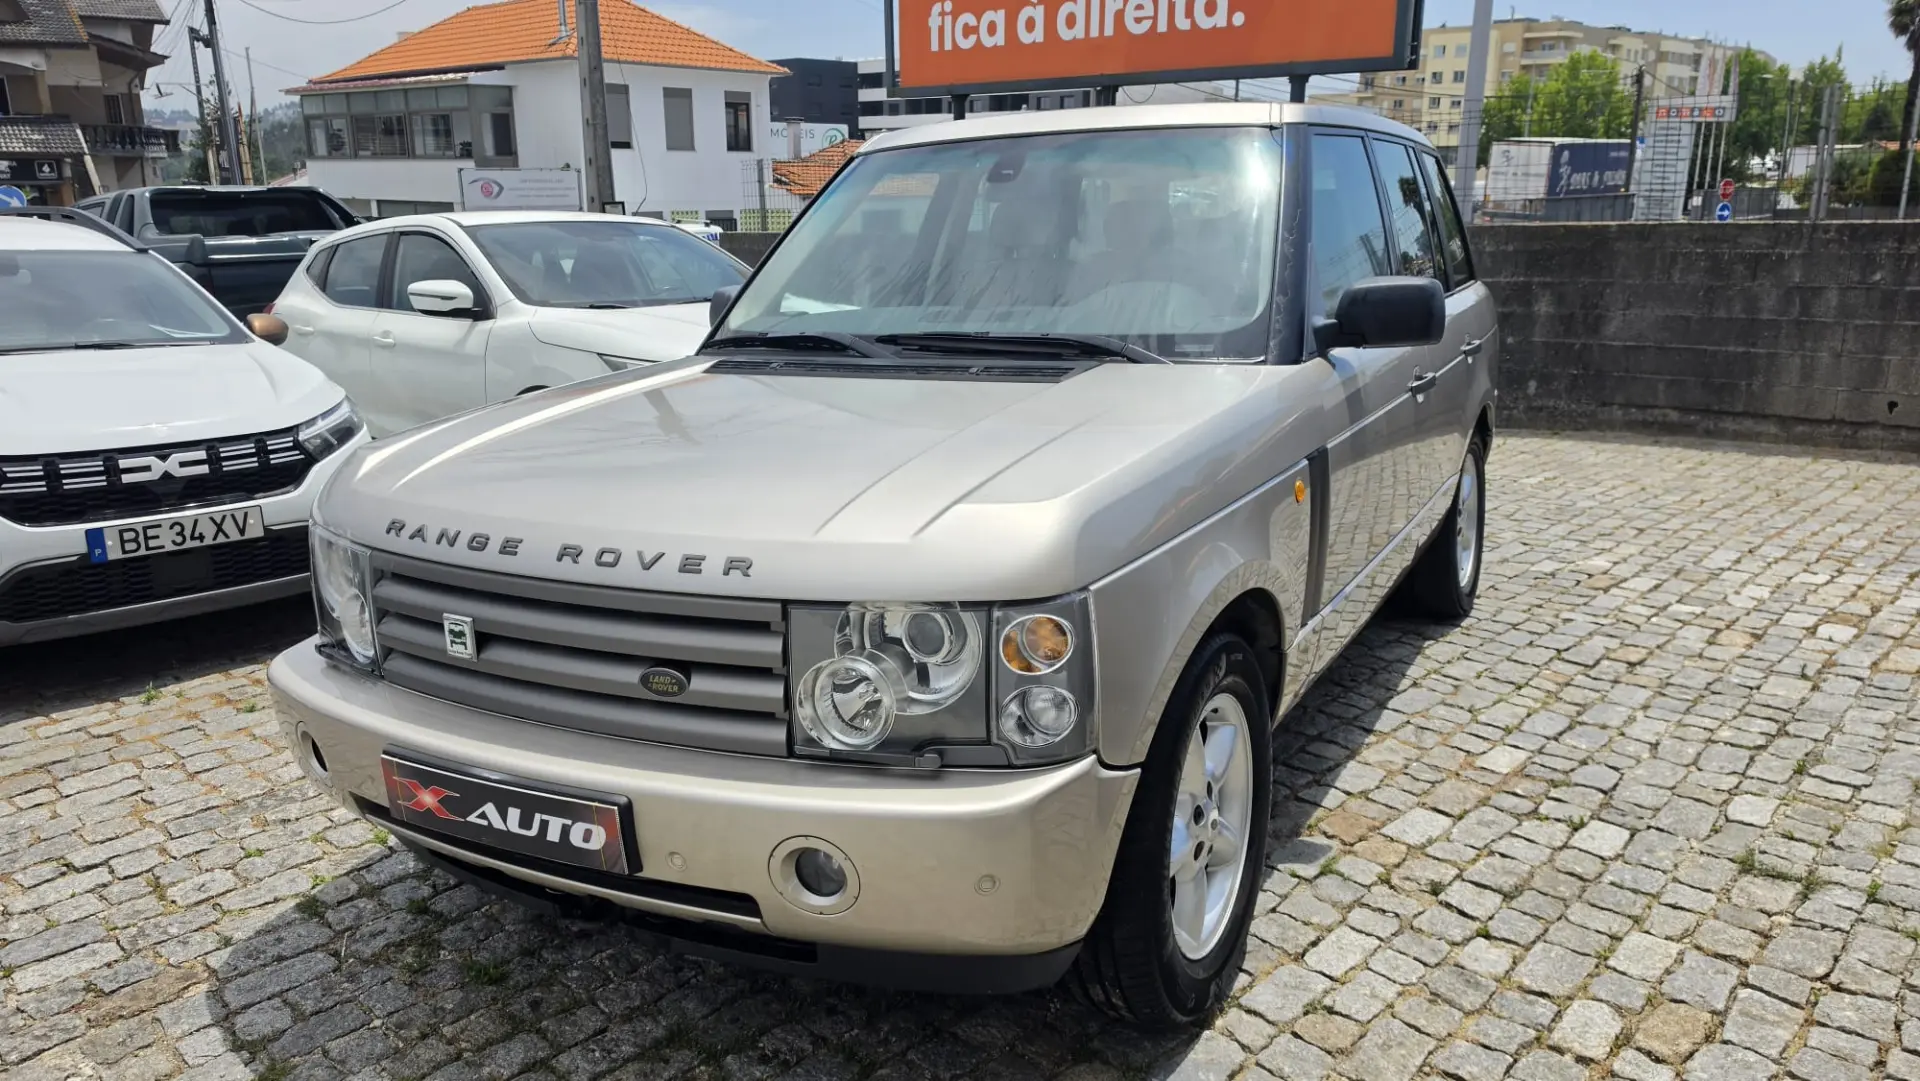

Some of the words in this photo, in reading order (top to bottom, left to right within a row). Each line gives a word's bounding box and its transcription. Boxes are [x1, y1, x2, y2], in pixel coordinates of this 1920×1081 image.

[928, 1, 1005, 51] fica
[385, 518, 523, 556] RANGE
[556, 543, 753, 577] ROVER
[649, 674, 671, 684] LAND
[652, 682, 679, 692] ROVER
[392, 776, 465, 822] X
[466, 801, 607, 850] AUTO
